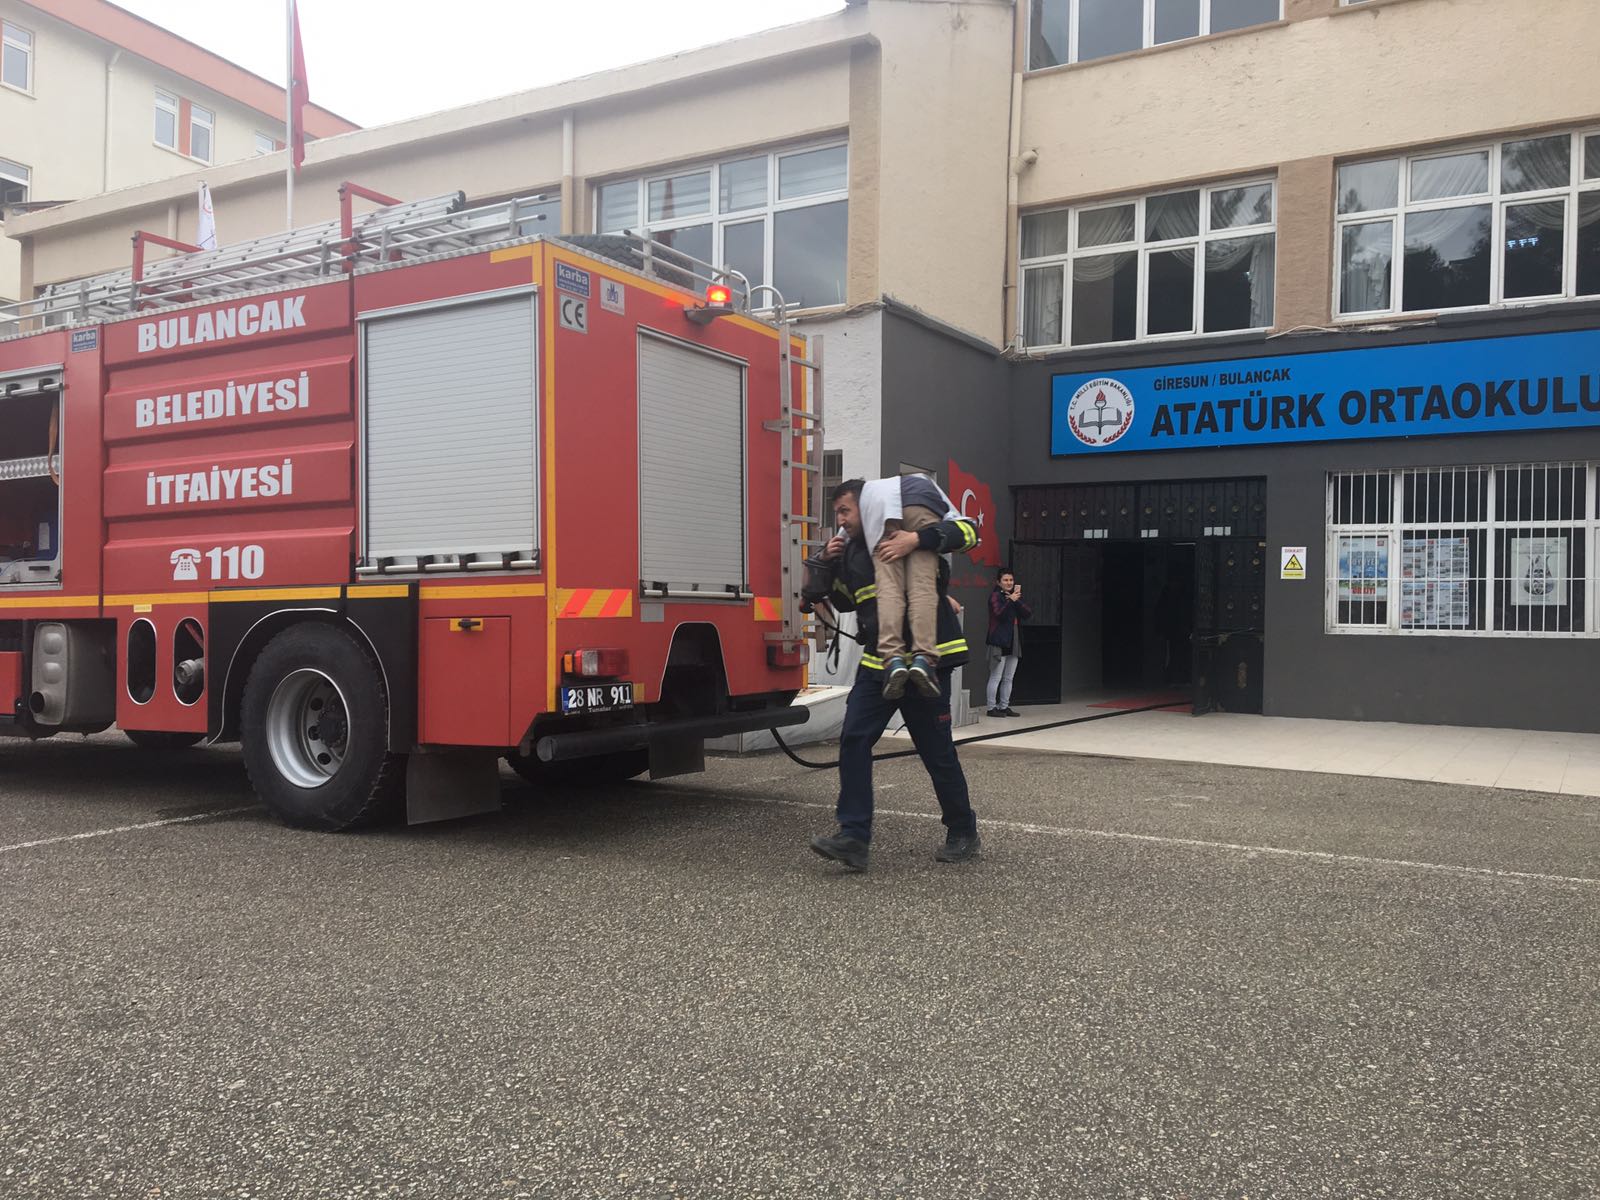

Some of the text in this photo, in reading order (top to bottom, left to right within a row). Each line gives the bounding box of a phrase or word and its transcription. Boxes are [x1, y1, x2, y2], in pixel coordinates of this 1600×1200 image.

[559, 264, 588, 285] karba
[138, 295, 306, 352] BULANCAK
[136, 371, 309, 428] BELEDİYESİ
[1153, 375, 1209, 391] GİRESUN
[1219, 368, 1291, 386] BULANCAK
[1150, 375, 1600, 437] ATATÜRK ORTAOKULU
[146, 458, 292, 506] İTFAİYESİ
[205, 544, 265, 580] 110
[568, 686, 631, 708] 28 NR 911
